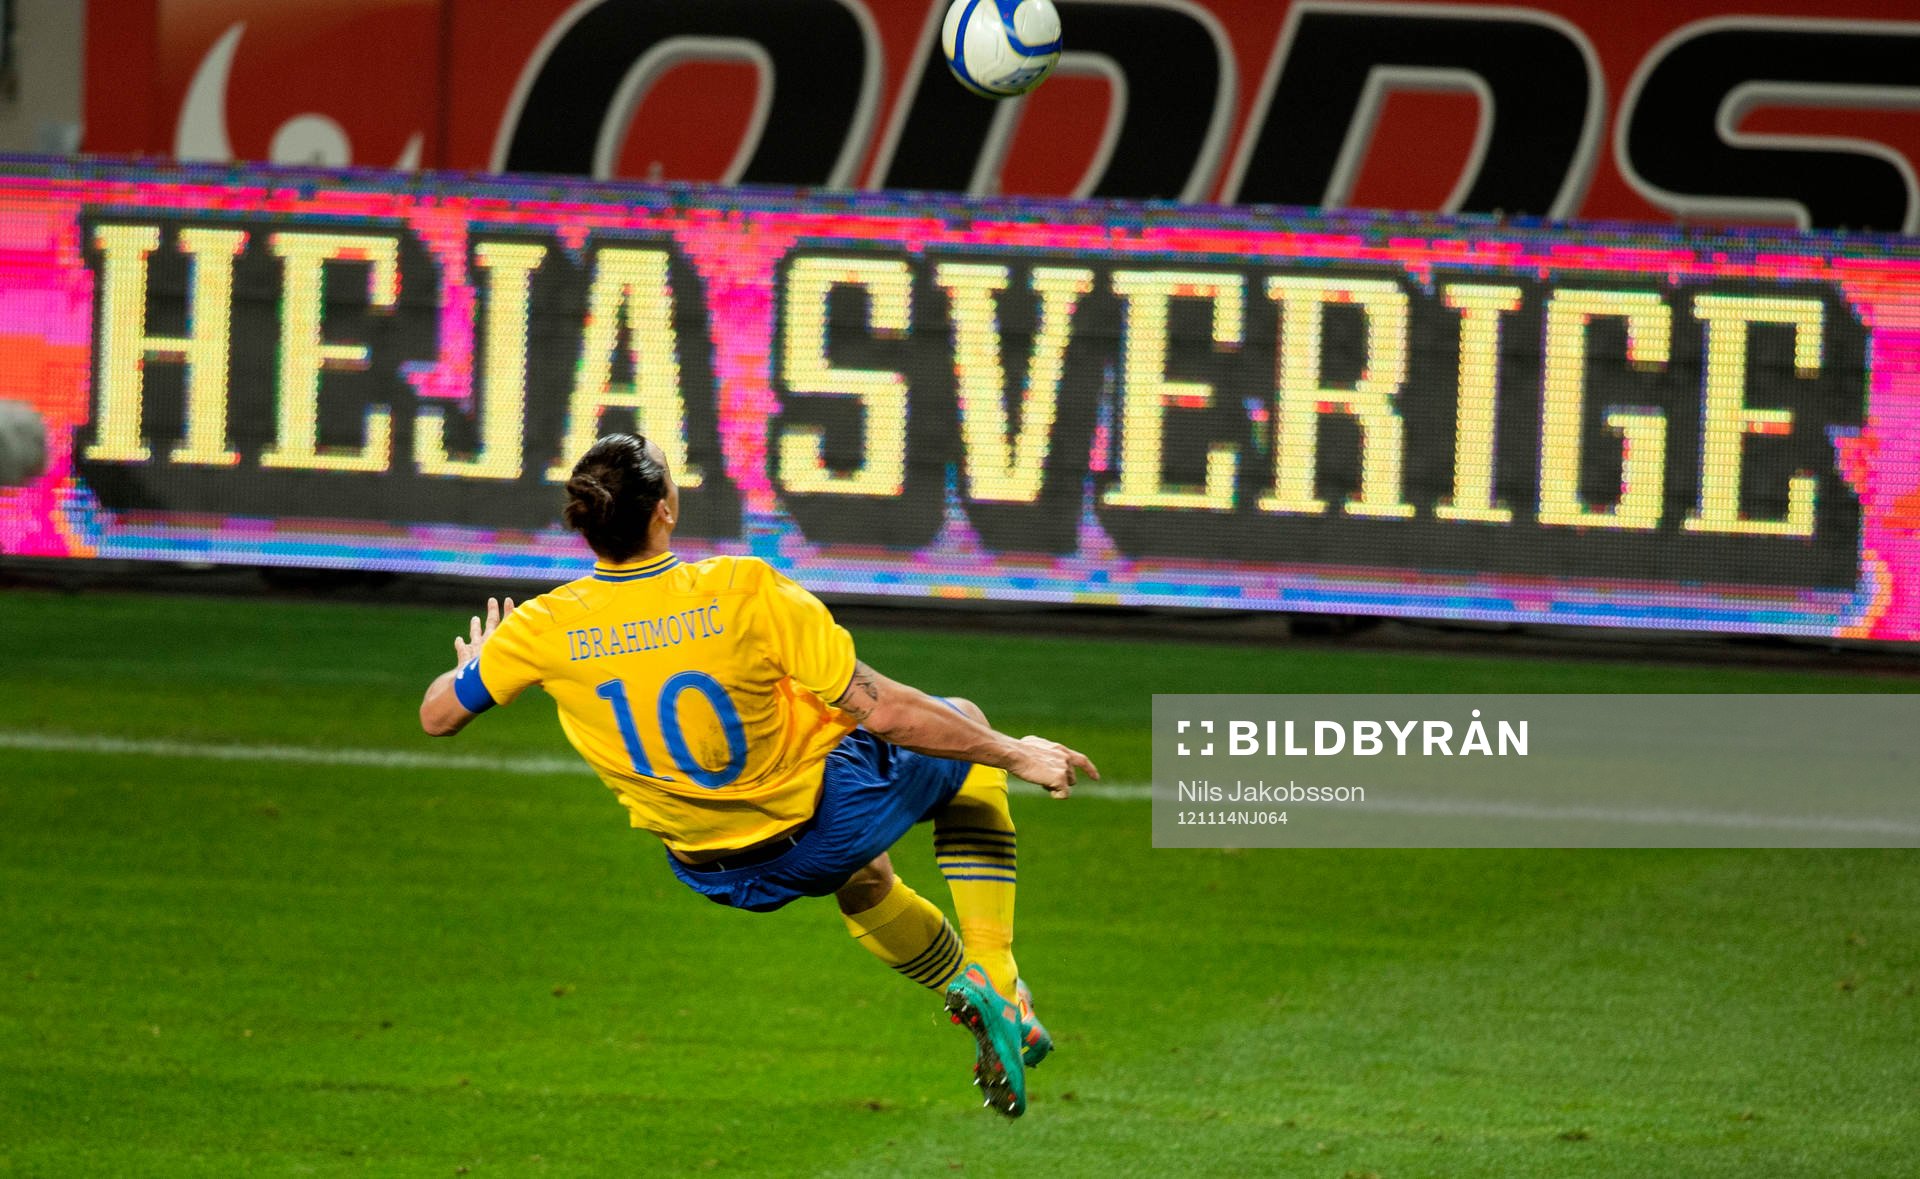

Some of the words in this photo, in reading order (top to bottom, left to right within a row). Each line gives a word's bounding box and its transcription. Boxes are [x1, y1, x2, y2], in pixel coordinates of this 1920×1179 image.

[85, 224, 703, 488] HEJA
[778, 256, 1825, 537] SVERIGE
[567, 598, 725, 661] IBRAHIMOVIĆ
[596, 670, 747, 790] 10
